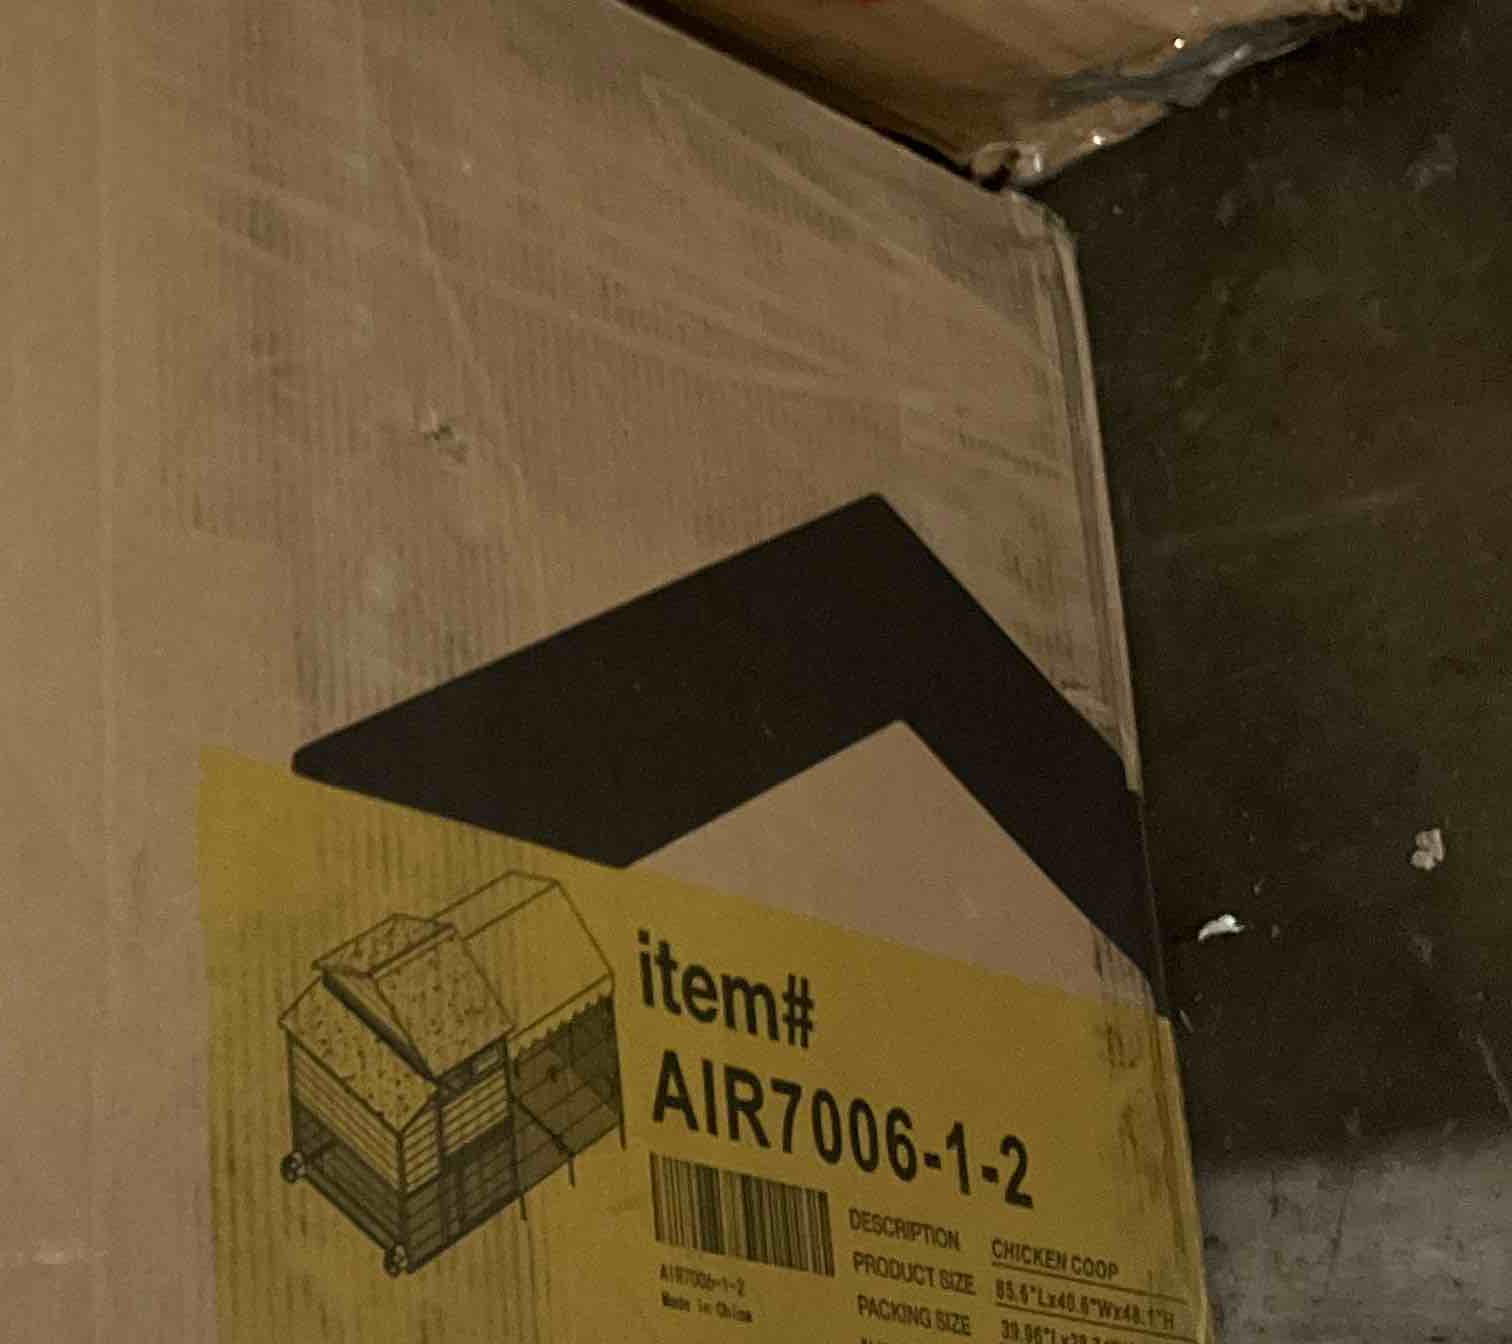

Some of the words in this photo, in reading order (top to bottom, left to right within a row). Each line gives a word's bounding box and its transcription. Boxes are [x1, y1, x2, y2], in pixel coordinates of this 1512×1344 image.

[637, 928, 816, 1050] item#
[652, 1048, 1034, 1210] AIR7006-1-2
[848, 1208, 961, 1251] DESCRIPTION
[992, 1238, 1067, 1269] CHICKEN
[1071, 1256, 1119, 1281] COOP
[852, 1251, 936, 1288] PRODUCT
[939, 1269, 977, 1296] SIZE
[857, 1294, 932, 1330] PACKING
[935, 1309, 972, 1337] SIZE
